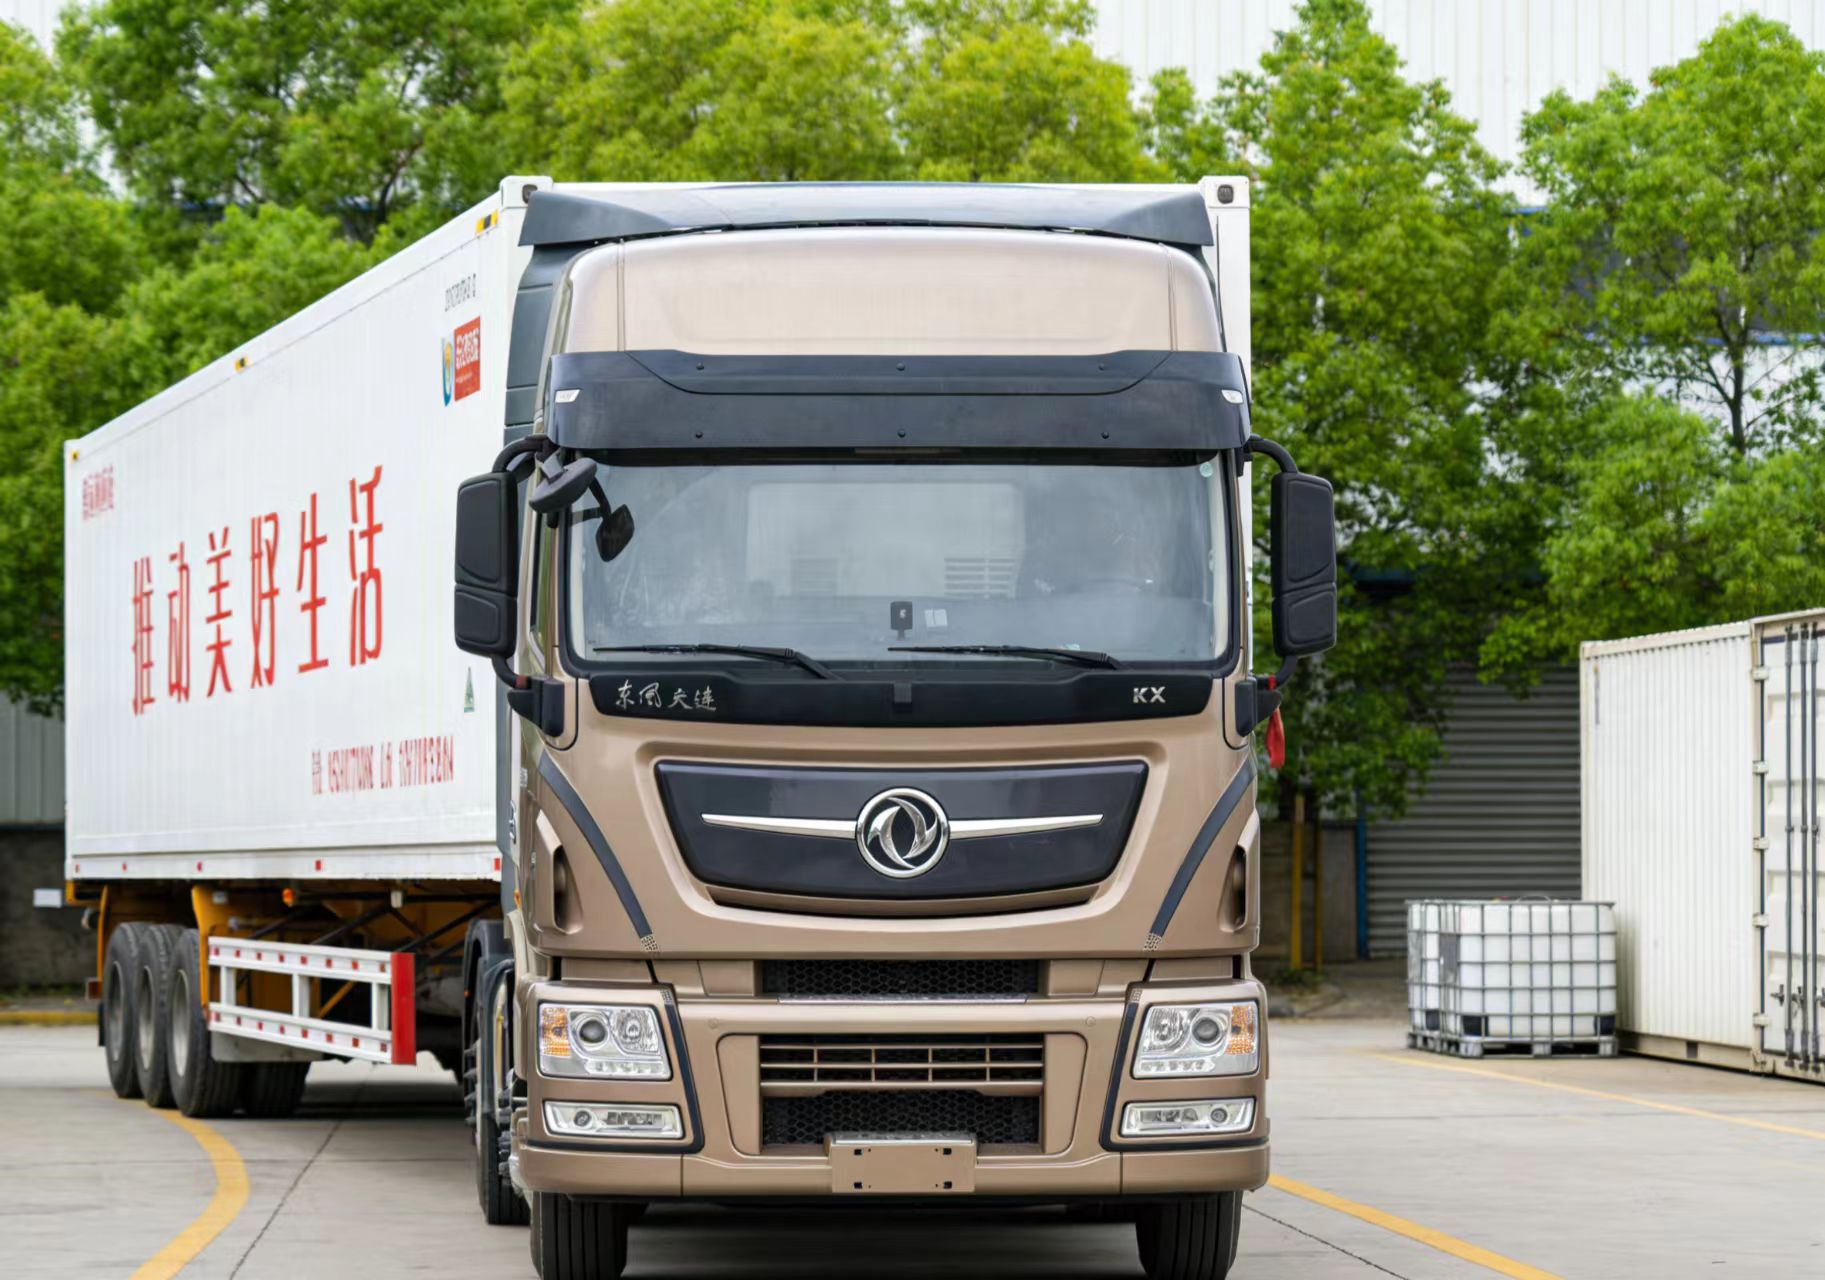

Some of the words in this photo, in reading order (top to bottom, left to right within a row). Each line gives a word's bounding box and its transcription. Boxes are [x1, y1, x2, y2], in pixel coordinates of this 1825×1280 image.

[132, 465, 383, 716] 推动美好生活
[1132, 686, 1166, 704] KX
